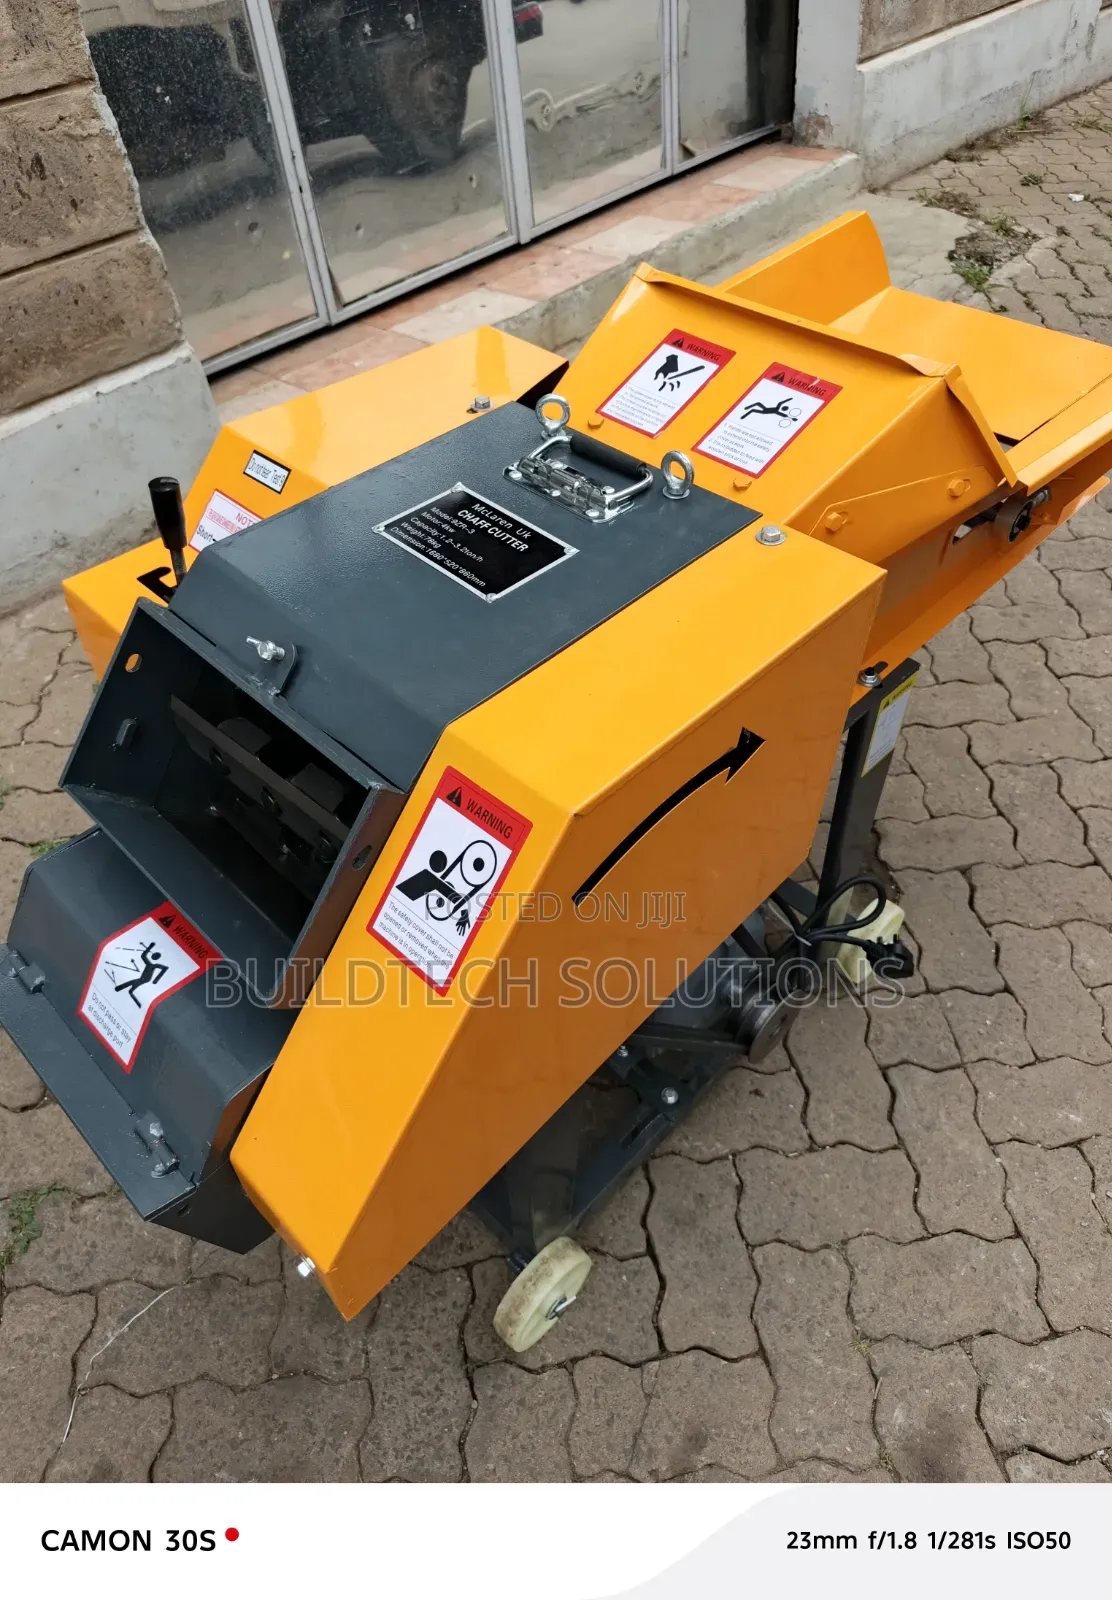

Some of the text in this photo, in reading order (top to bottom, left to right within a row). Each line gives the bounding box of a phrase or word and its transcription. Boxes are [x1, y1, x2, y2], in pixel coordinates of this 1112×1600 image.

[687, 344, 721, 361] WARNING
[788, 378, 826, 396] WARNING
[196, 525, 213, 543] Short
[458, 510, 528, 551] CHAFF CUTTER
[472, 503, 531, 539] McLaren Uk
[466, 799, 513, 839] WARNING
[173, 925, 209, 959] WARNING
[379, 922, 399, 941] machine
[398, 937, 404, 945] is
[402, 941, 409, 950] in
[383, 912, 402, 930] opened
[400, 926, 408, 934] or
[406, 931, 428, 952] removed
[427, 949, 441, 965] when
[389, 901, 454, 959] The safety cover shall not be
[88, 1004, 124, 1048] at discharge port
[91, 992, 132, 1043] Do not pass or stay
